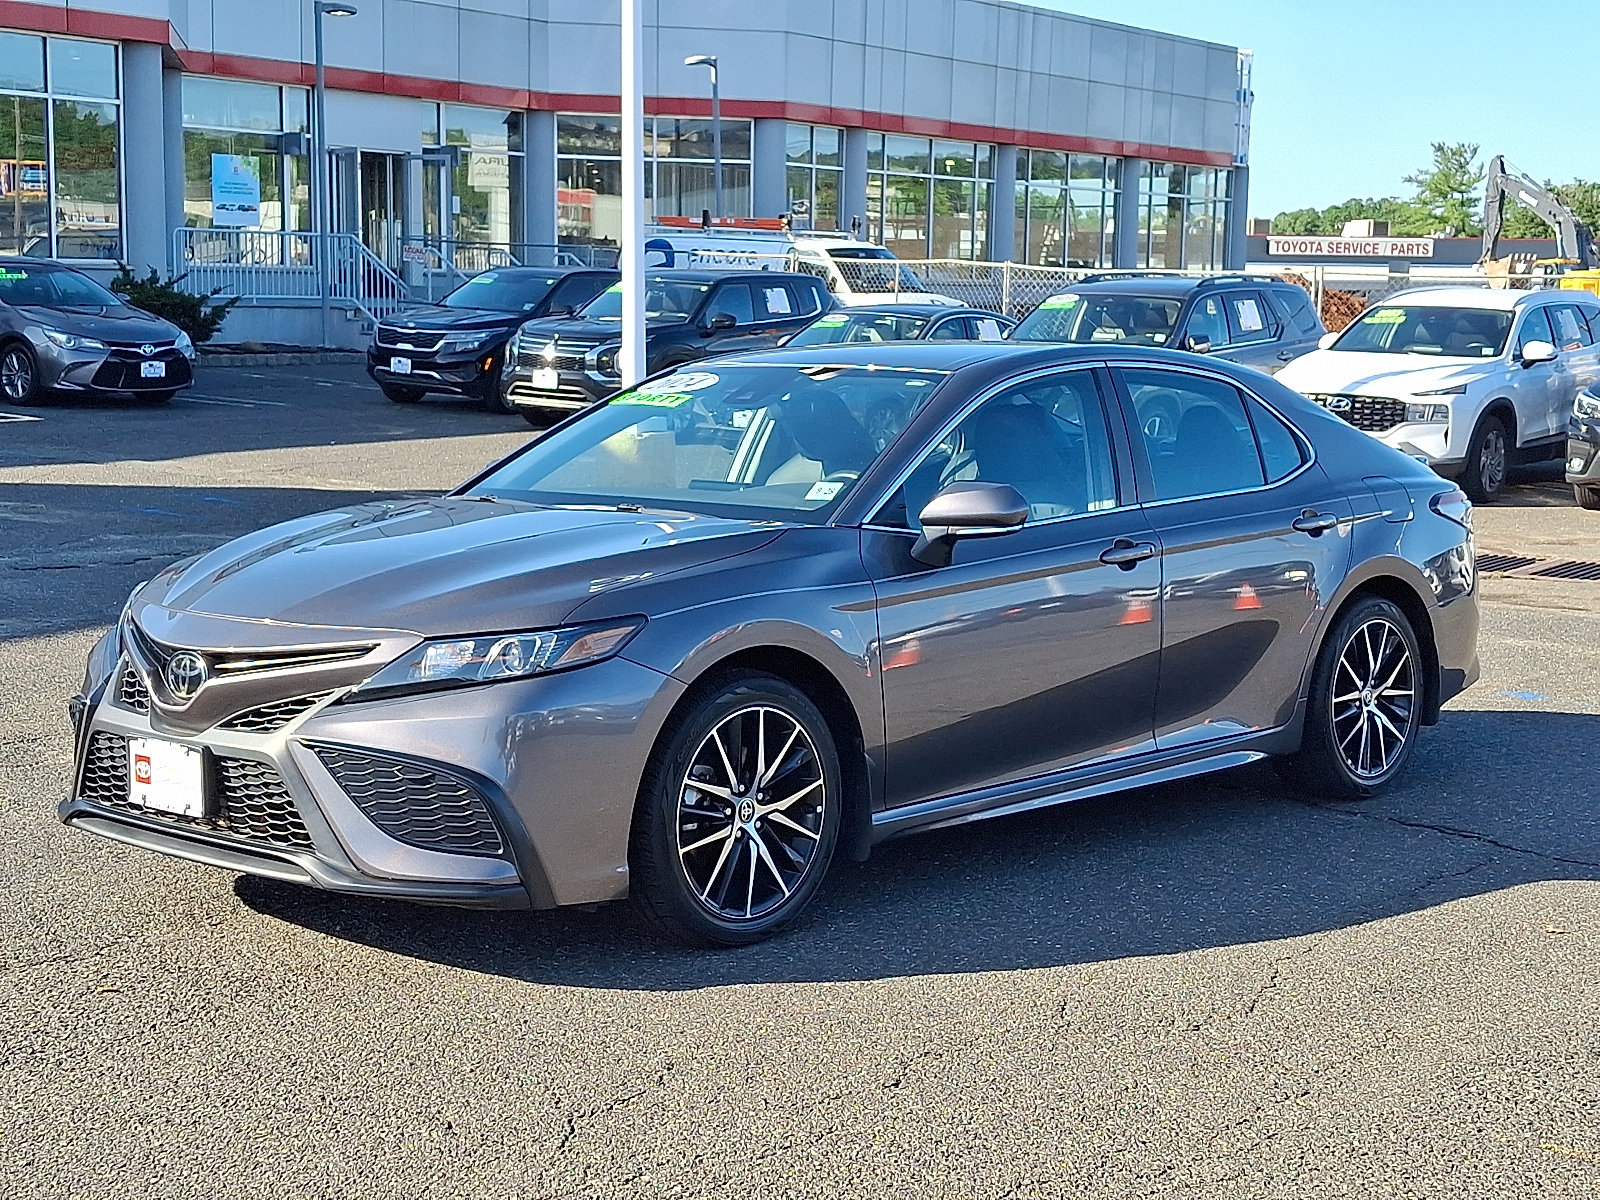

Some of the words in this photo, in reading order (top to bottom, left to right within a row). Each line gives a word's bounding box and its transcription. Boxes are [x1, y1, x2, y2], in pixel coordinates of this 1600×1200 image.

[1274, 240, 1323, 253] TOYOTA
[1327, 241, 1379, 255] SERVICE
[1391, 243, 1429, 255] PARTS
